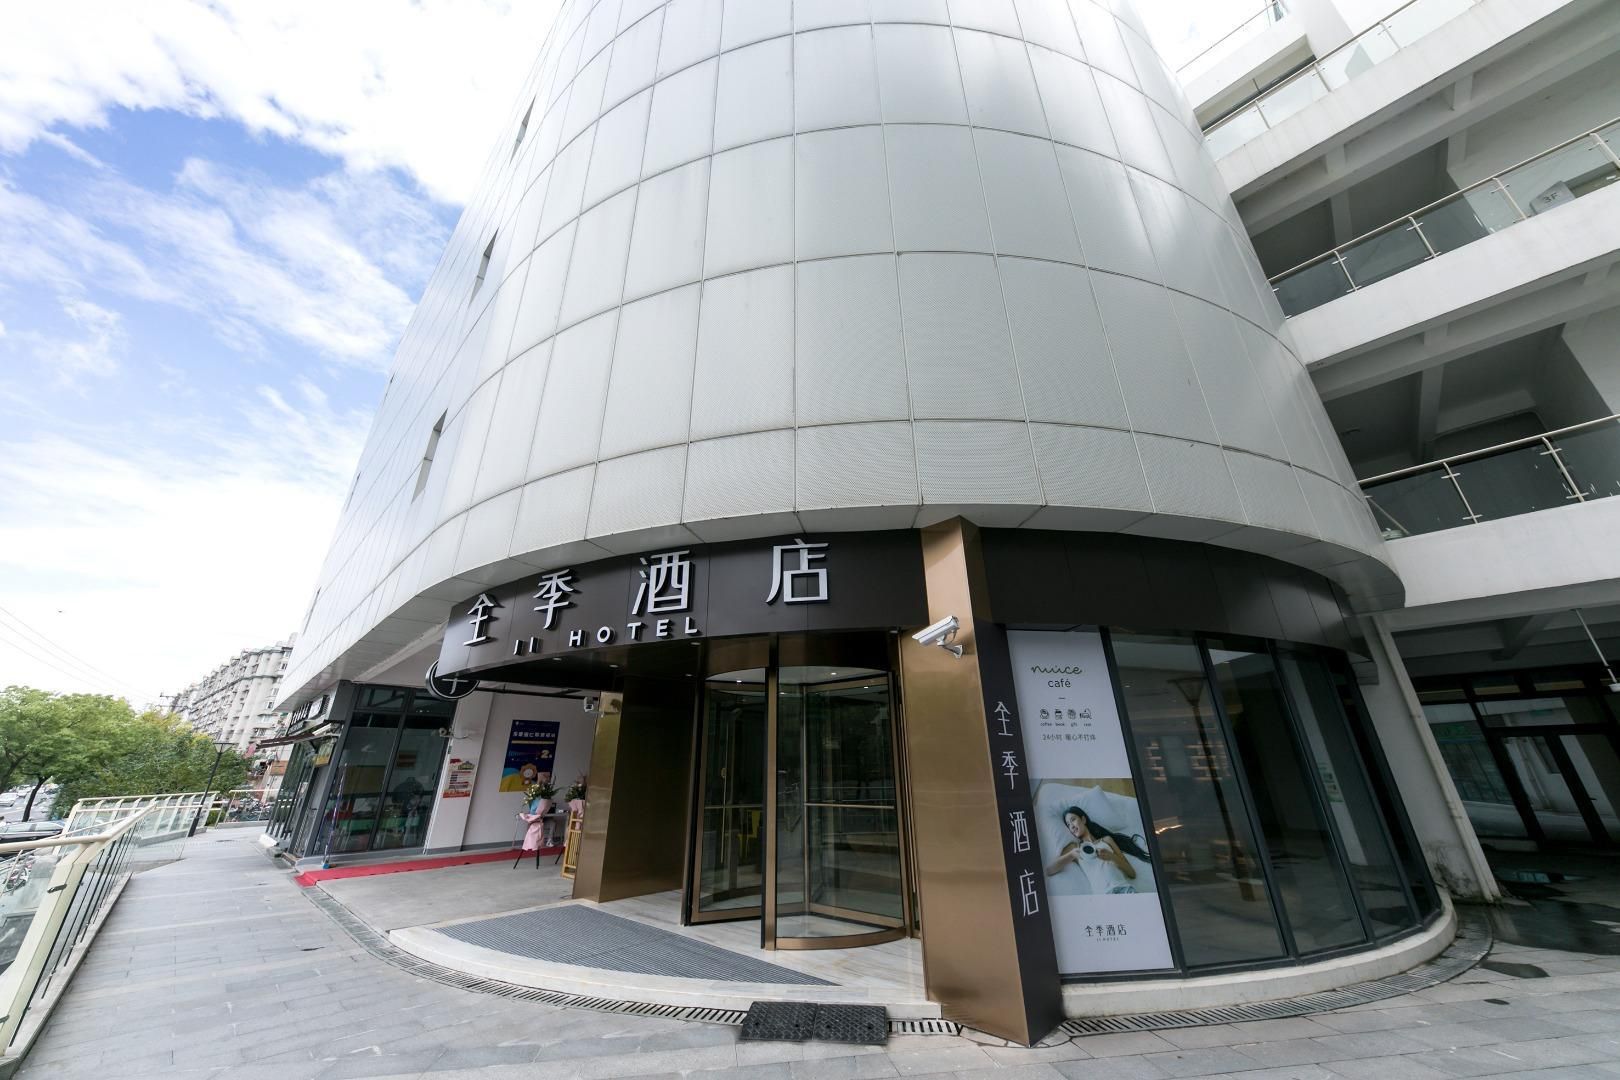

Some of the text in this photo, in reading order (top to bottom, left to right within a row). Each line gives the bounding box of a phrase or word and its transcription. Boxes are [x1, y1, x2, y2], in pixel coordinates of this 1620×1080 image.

[1543, 192, 1558, 204] 3F
[463, 538, 829, 647] 全季酒店
[569, 616, 698, 647] HOTEL
[1047, 678, 1071, 688] café
[993, 701, 1039, 917] 全季酒店
